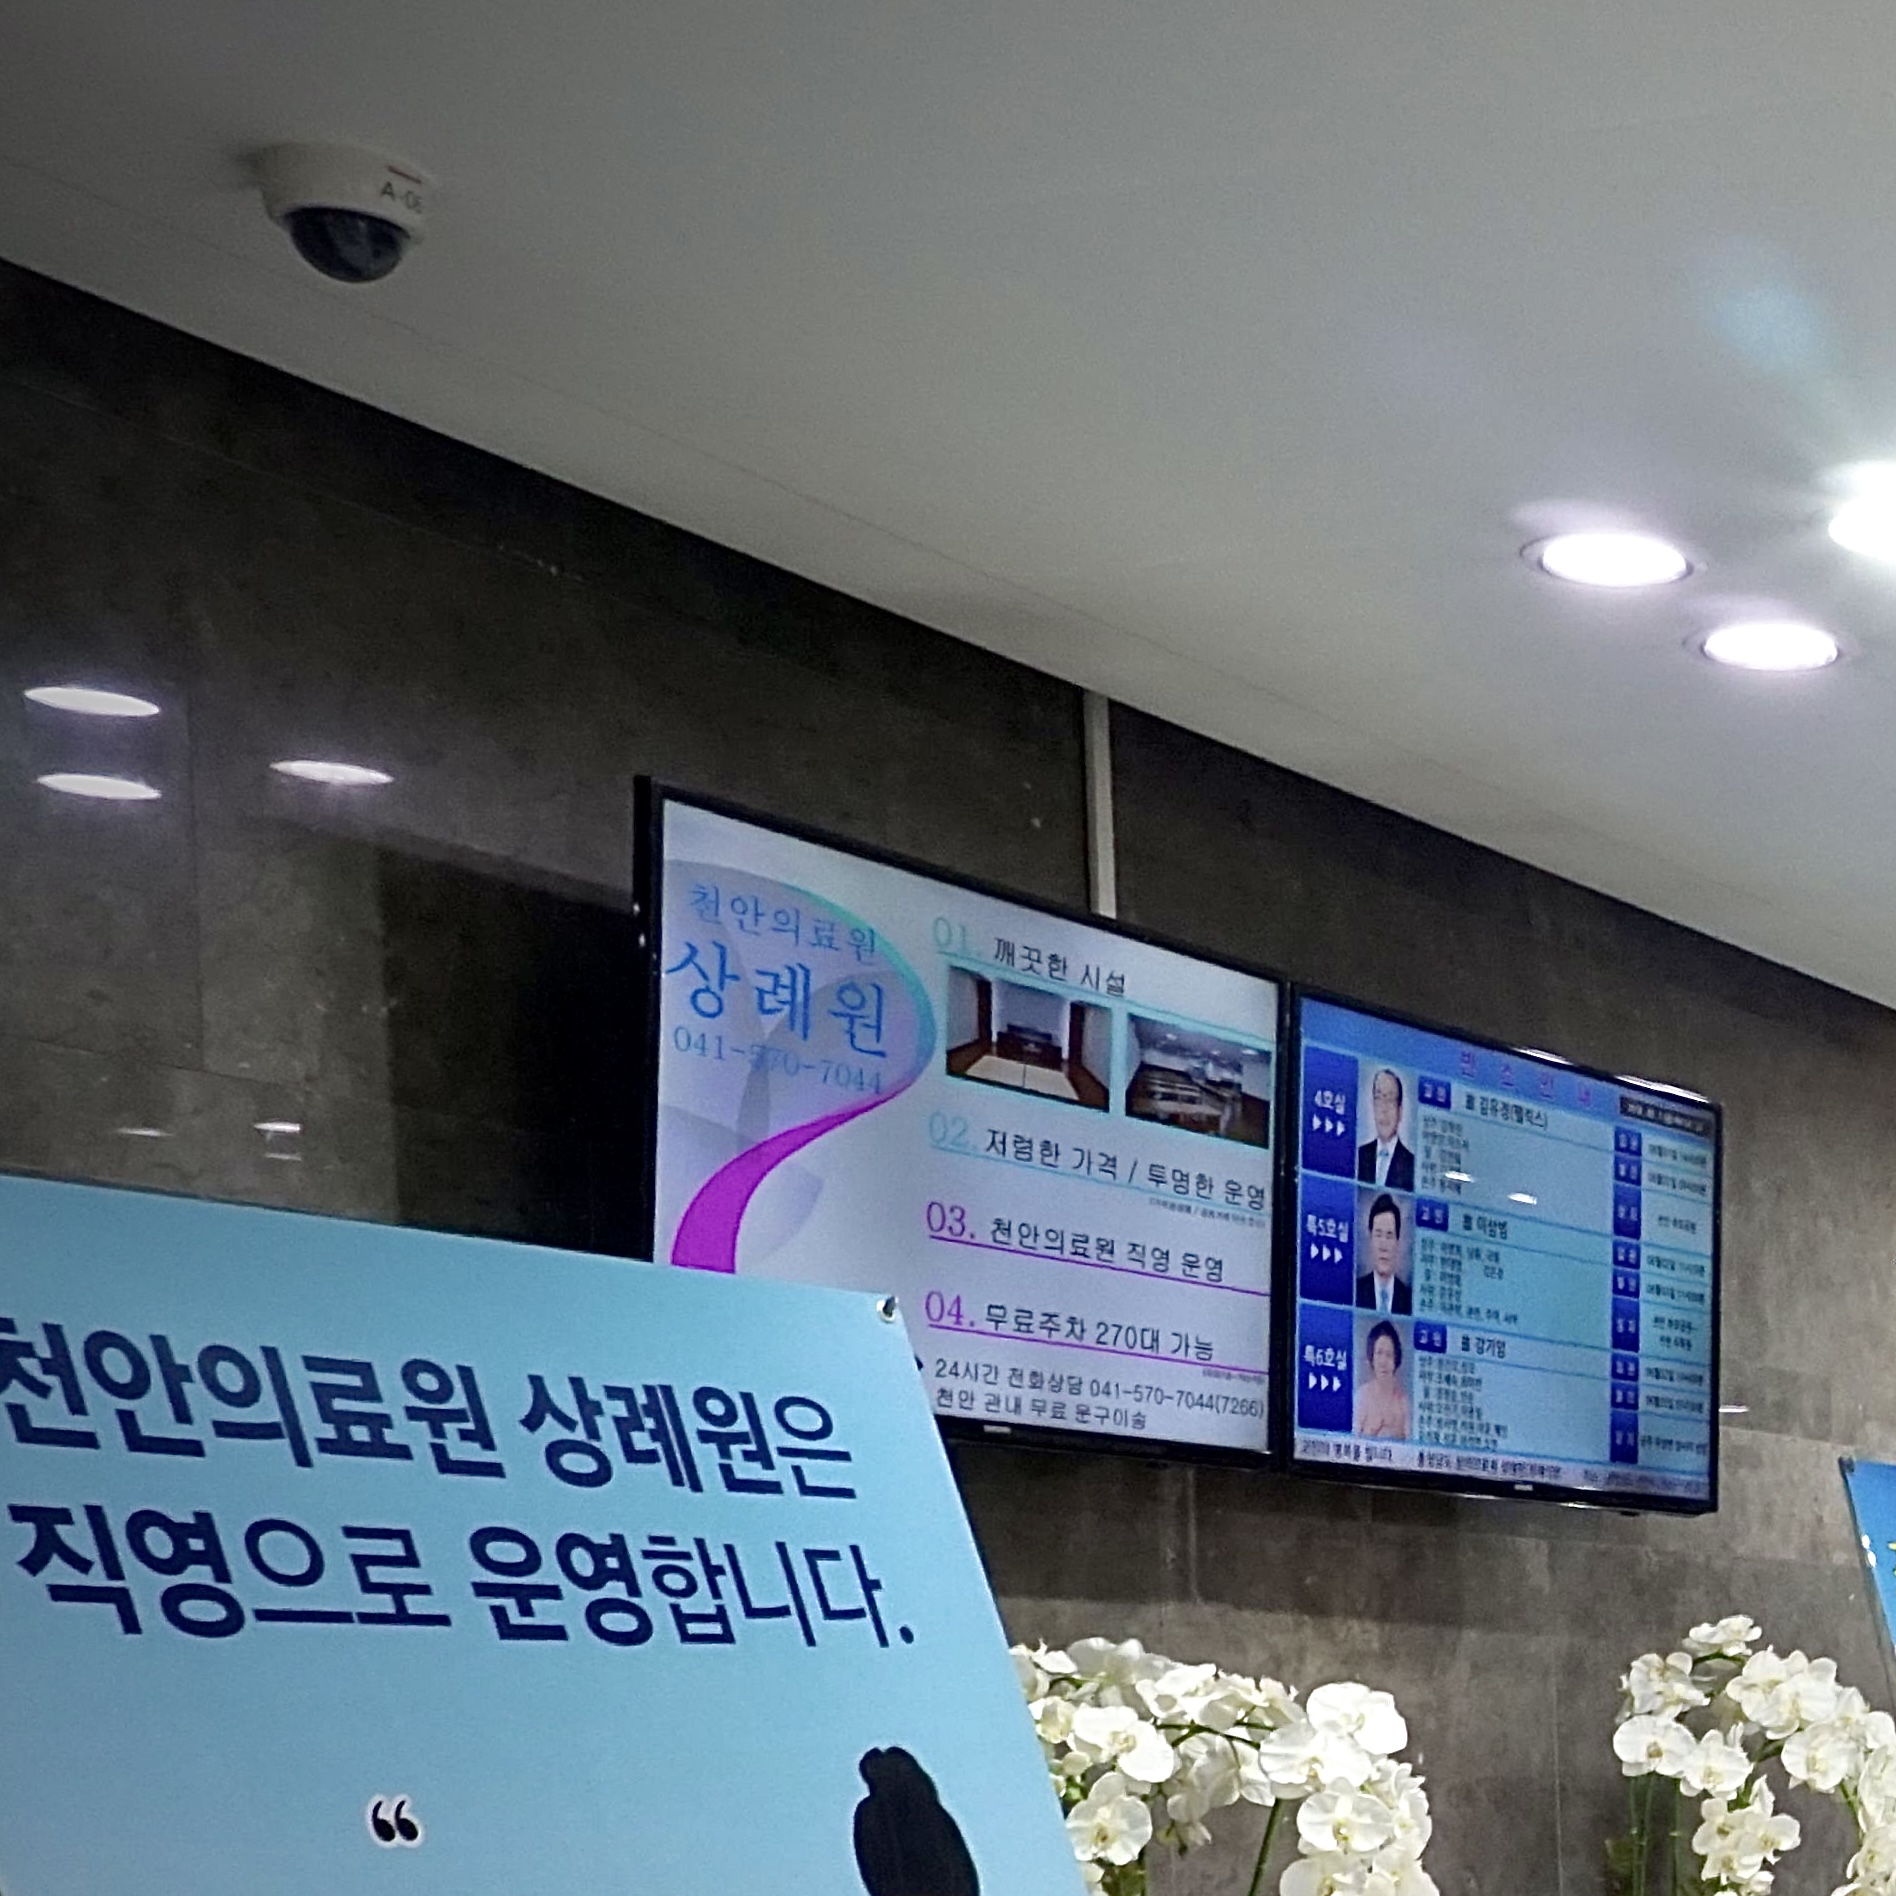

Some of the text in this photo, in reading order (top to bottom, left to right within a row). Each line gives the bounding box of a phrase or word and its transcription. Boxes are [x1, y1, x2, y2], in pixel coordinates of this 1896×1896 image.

[690, 884, 876, 967] 천안의료원
[993, 937, 1068, 982] 깨끗한
[1080, 964, 1125, 998] 시설
[664, 940, 887, 1058] 상례원
[986, 1127, 1061, 1169] 저렴한
[1072, 1147, 1118, 1181] 가격
[1147, 1162, 1215, 1201] 투명한
[1223, 1179, 1266, 1212] 운영
[926, 1200, 1224, 1284] 03. 천안의료원 직영 운영
[925, 1290, 1215, 1362] 04. 무료주차 270대 가능
[0, 1316, 858, 1501] 천안의료원 상례원은
[935, 1358, 999, 1386] 24시간
[1007, 1366, 1083, 1396] 전화상담
[7, 1502, 915, 1650] 직영으로 운영합니다.
